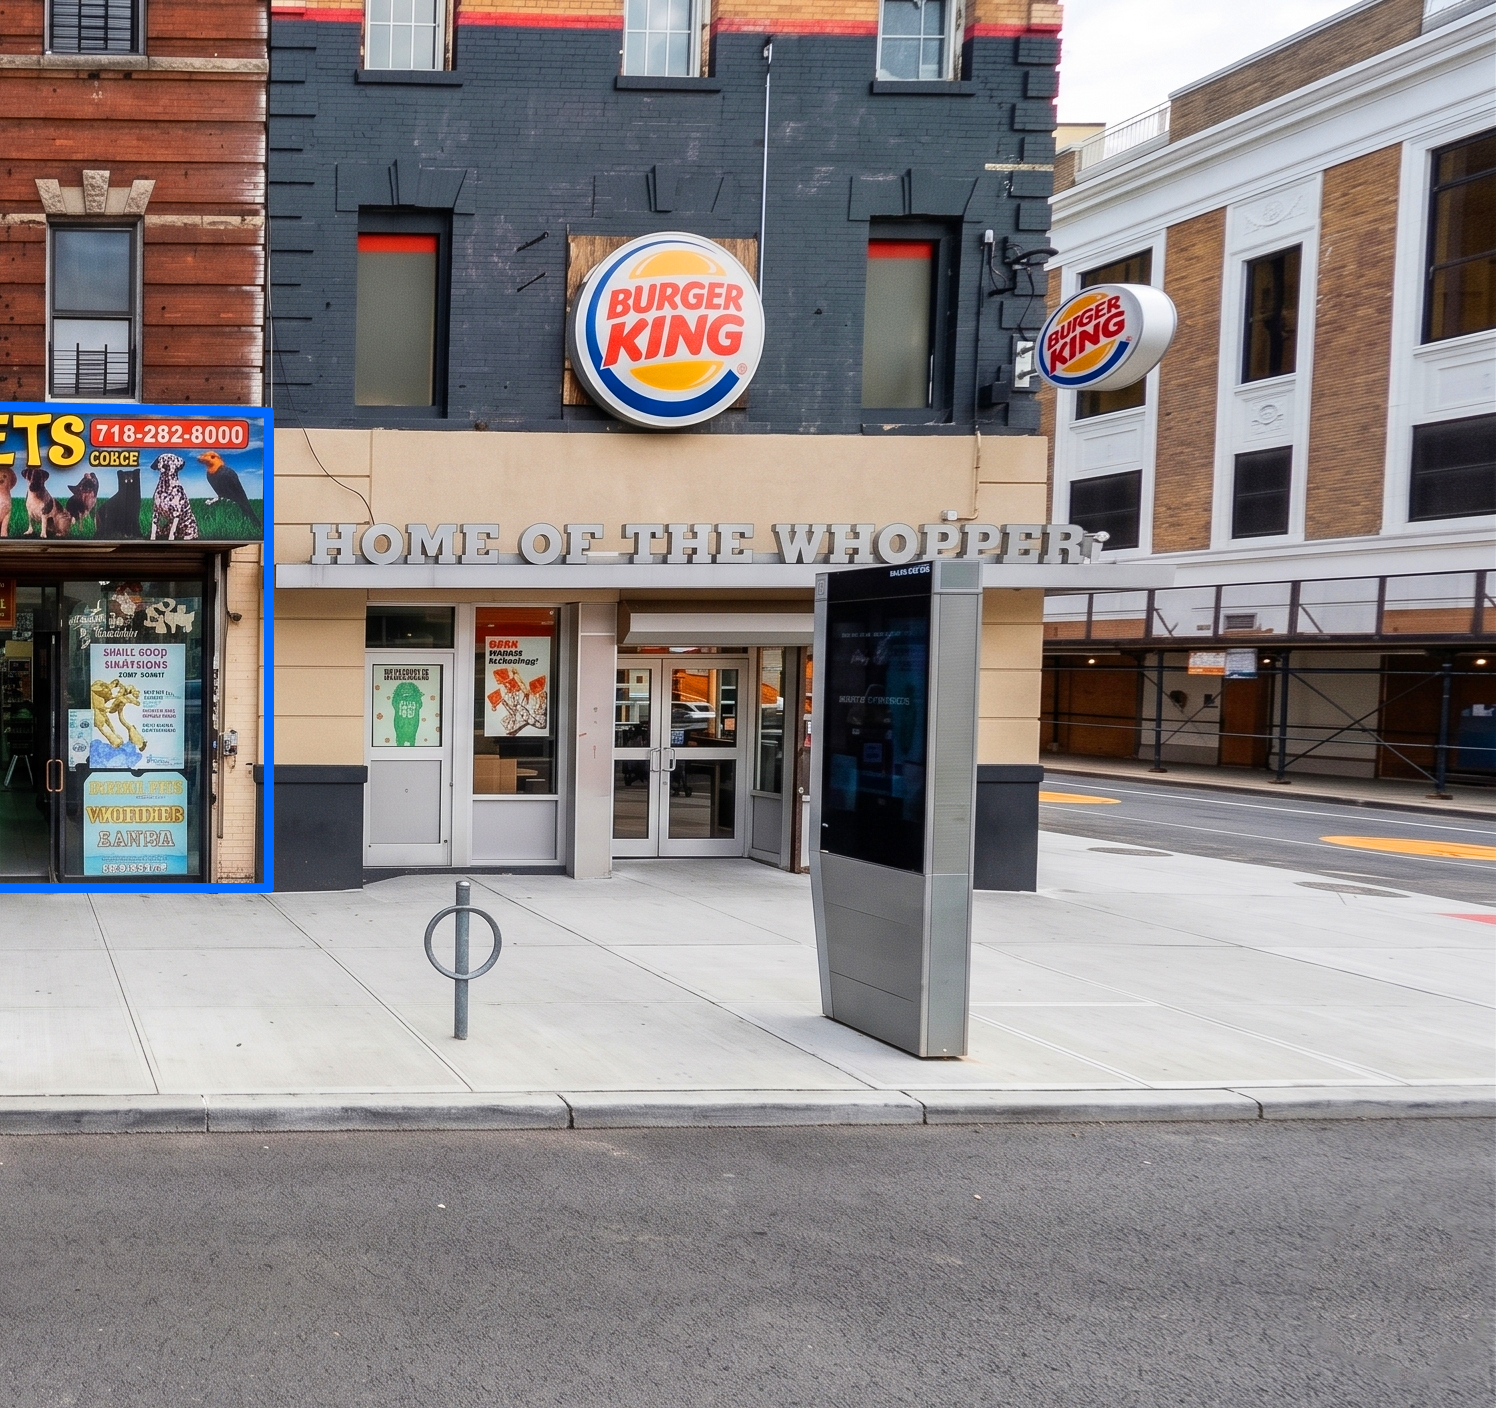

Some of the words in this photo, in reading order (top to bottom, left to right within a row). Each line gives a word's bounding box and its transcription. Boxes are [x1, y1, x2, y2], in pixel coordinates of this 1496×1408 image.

[605, 280, 744, 321] BURGER
[602, 313, 746, 368] KING
[1049, 310, 1126, 376] KING
[95, 424, 244, 445] 718-282-8000
[310, 523, 501, 565] HOME
[517, 523, 604, 565] OF
[621, 523, 755, 565] THE
[771, 523, 1085, 565] WHOPPER
